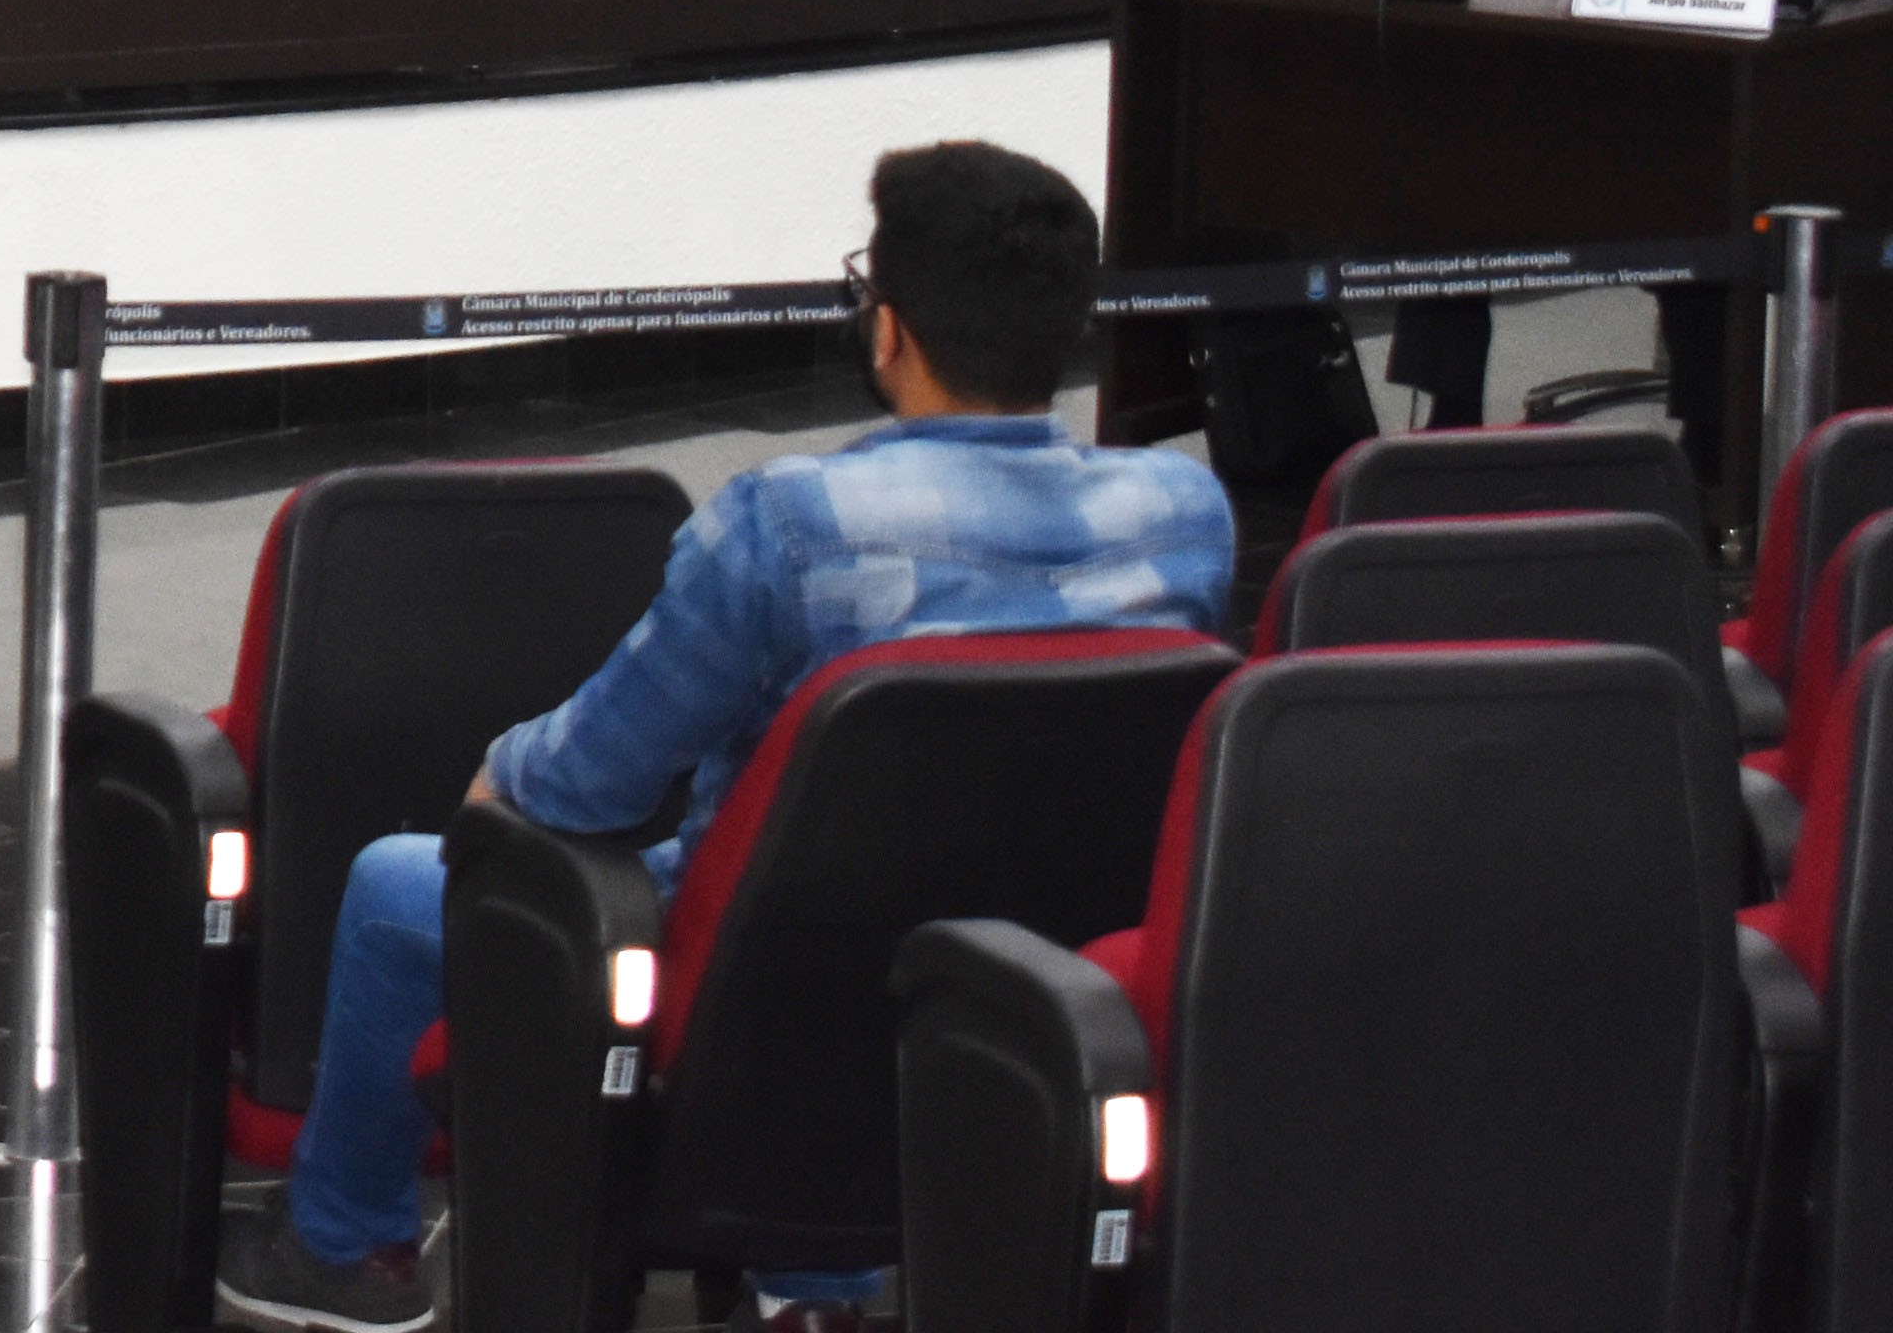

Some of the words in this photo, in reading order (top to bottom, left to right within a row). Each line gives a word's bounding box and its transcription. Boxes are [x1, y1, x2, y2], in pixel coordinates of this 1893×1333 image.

[1340, 261, 1392, 277] Câmara
[1393, 257, 1459, 275] Municipal
[1462, 255, 1478, 269] de
[1481, 249, 1572, 270] Cordeirópolis
[1339, 284, 1385, 300] Acesso
[1387, 281, 1439, 298] restrito
[1442, 279, 1488, 296] apenas
[1489, 276, 1521, 292] para
[1523, 270, 1605, 288] funcionários
[462, 294, 522, 311] Câmara
[524, 291, 601, 310] Municipal
[604, 289, 624, 305] de
[626, 287, 732, 308] Cordeirópolis
[1119, 299, 1128, 312] e
[1130, 293, 1211, 311] Vereadores.
[206, 329, 216, 341] e
[219, 324, 312, 341] Vereadores.
[461, 318, 514, 335] Acesso
[516, 316, 576, 332] restrito
[579, 315, 634, 333] apenas
[635, 313, 672, 330] para
[675, 308, 771, 326] funcionários
[773, 311, 784, 322] e
